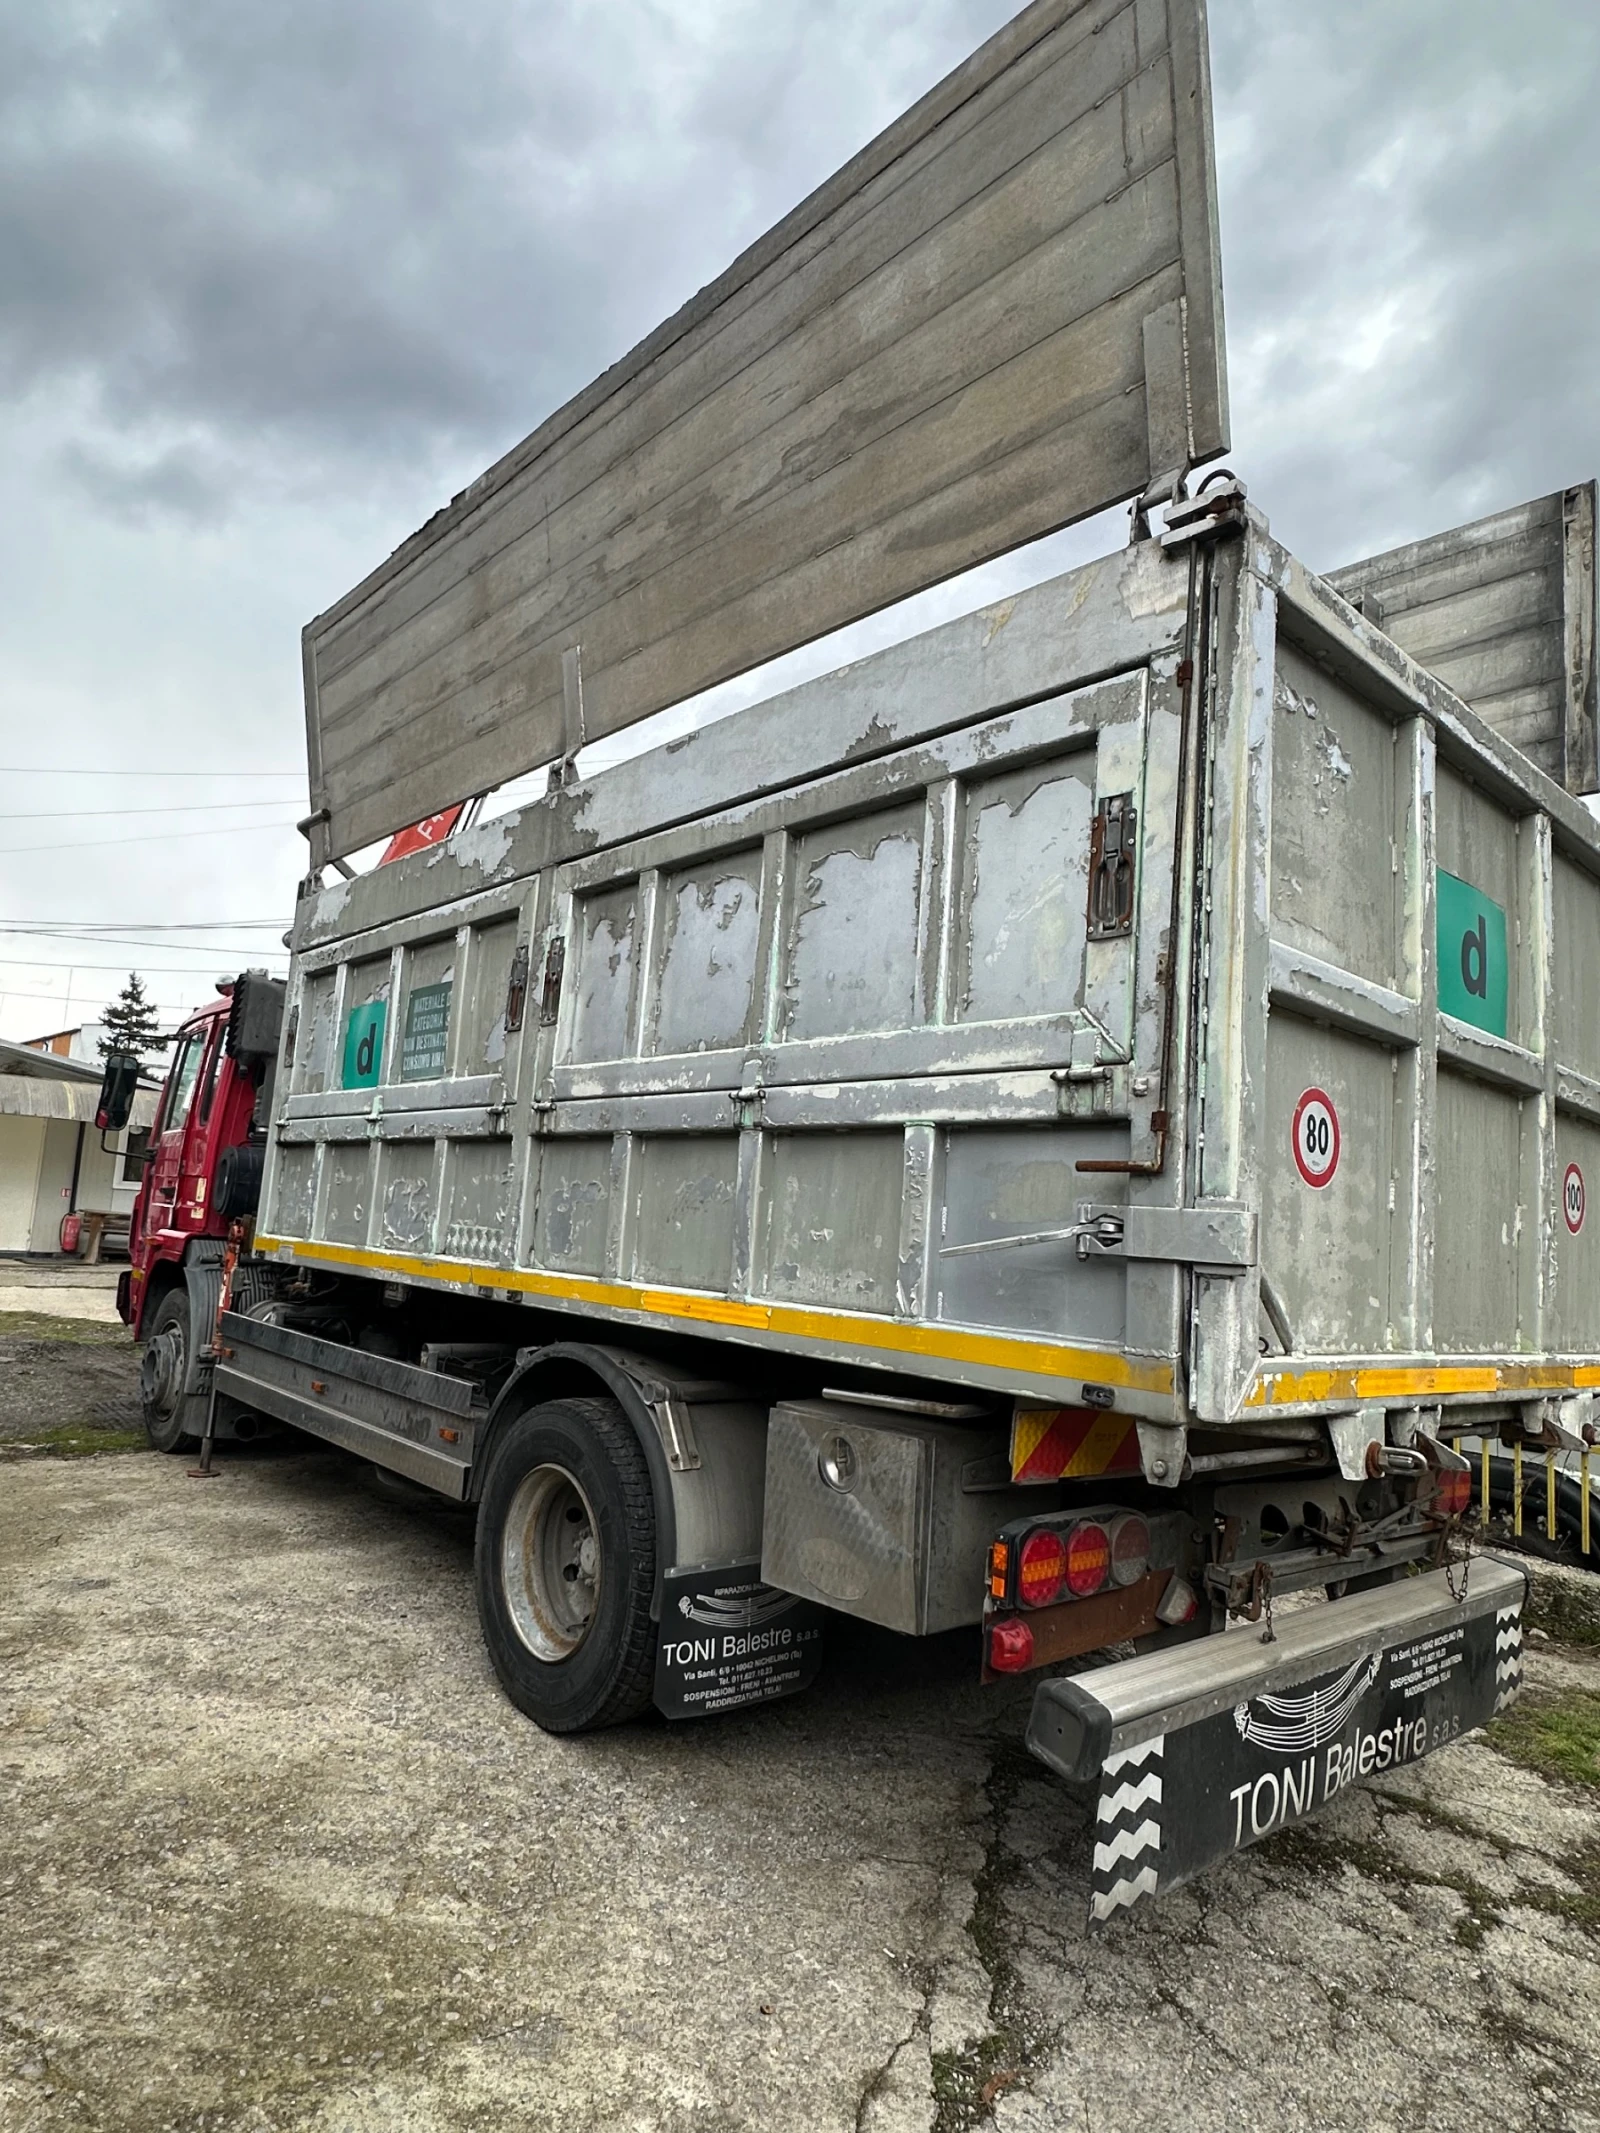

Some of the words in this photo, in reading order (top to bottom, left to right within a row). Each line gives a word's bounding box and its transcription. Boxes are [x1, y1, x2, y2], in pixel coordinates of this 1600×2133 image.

[1461, 914, 1486, 999] d
[357, 1022, 376, 1075] d
[431, 1052, 444, 1068] UMA
[1306, 1114, 1329, 1156] 80
[1567, 1182, 1581, 1212] 100
[663, 1638, 716, 1666] TONI
[722, 1628, 792, 1657] Balestre
[683, 1686, 736, 1702] SOSPENSIONI
[741, 1680, 760, 1692] FRENI
[684, 1671, 695, 1681] Via
[706, 1689, 762, 1709] RADDRIZZATURA
[1230, 1755, 1316, 1848] TONI
[1323, 1716, 1427, 1802] Balestre
